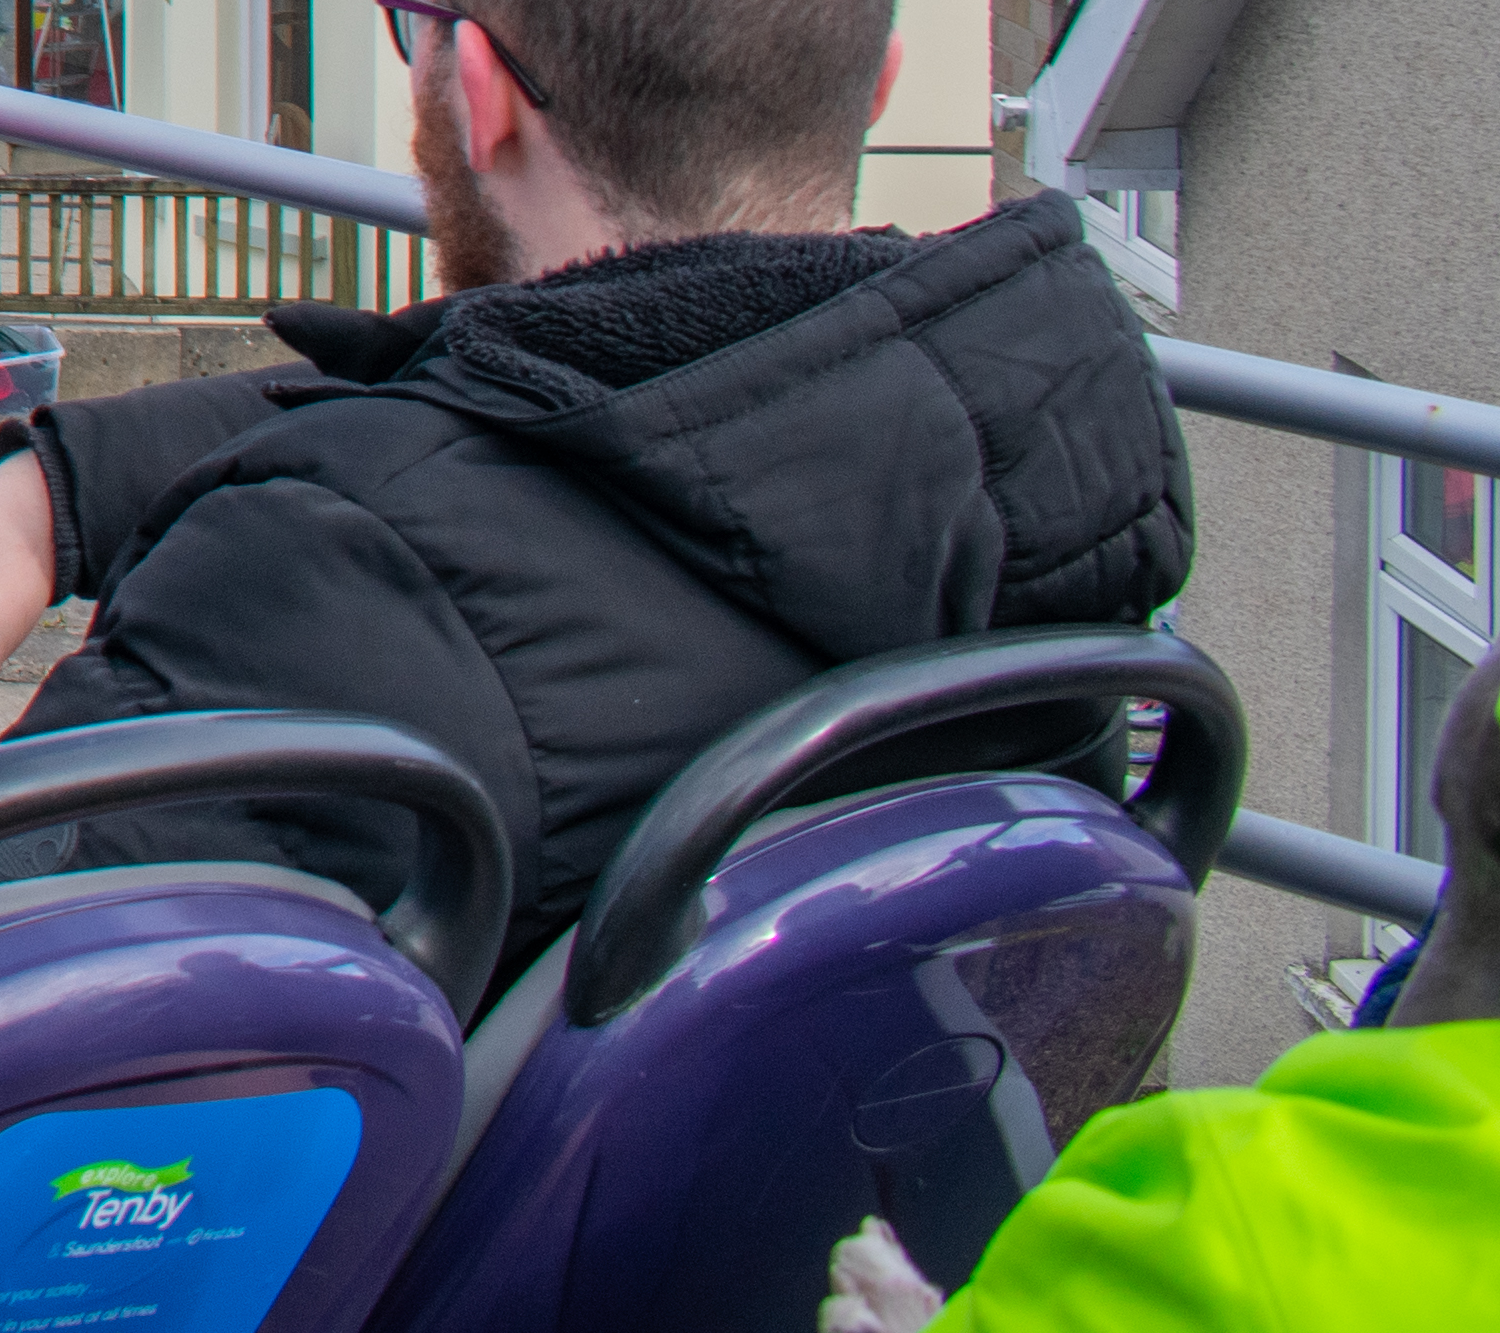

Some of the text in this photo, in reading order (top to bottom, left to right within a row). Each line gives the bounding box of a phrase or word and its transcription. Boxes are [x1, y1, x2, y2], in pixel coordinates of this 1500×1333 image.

[80, 1165, 158, 1188] explore
[79, 1185, 194, 1230] Tenby
[9, 1288, 45, 1306] your
[2, 1320, 18, 1332] in
[52, 1313, 85, 1328] seat
[85, 1311, 101, 1324] at
[102, 1307, 122, 1321] all
[121, 1304, 159, 1318] times
